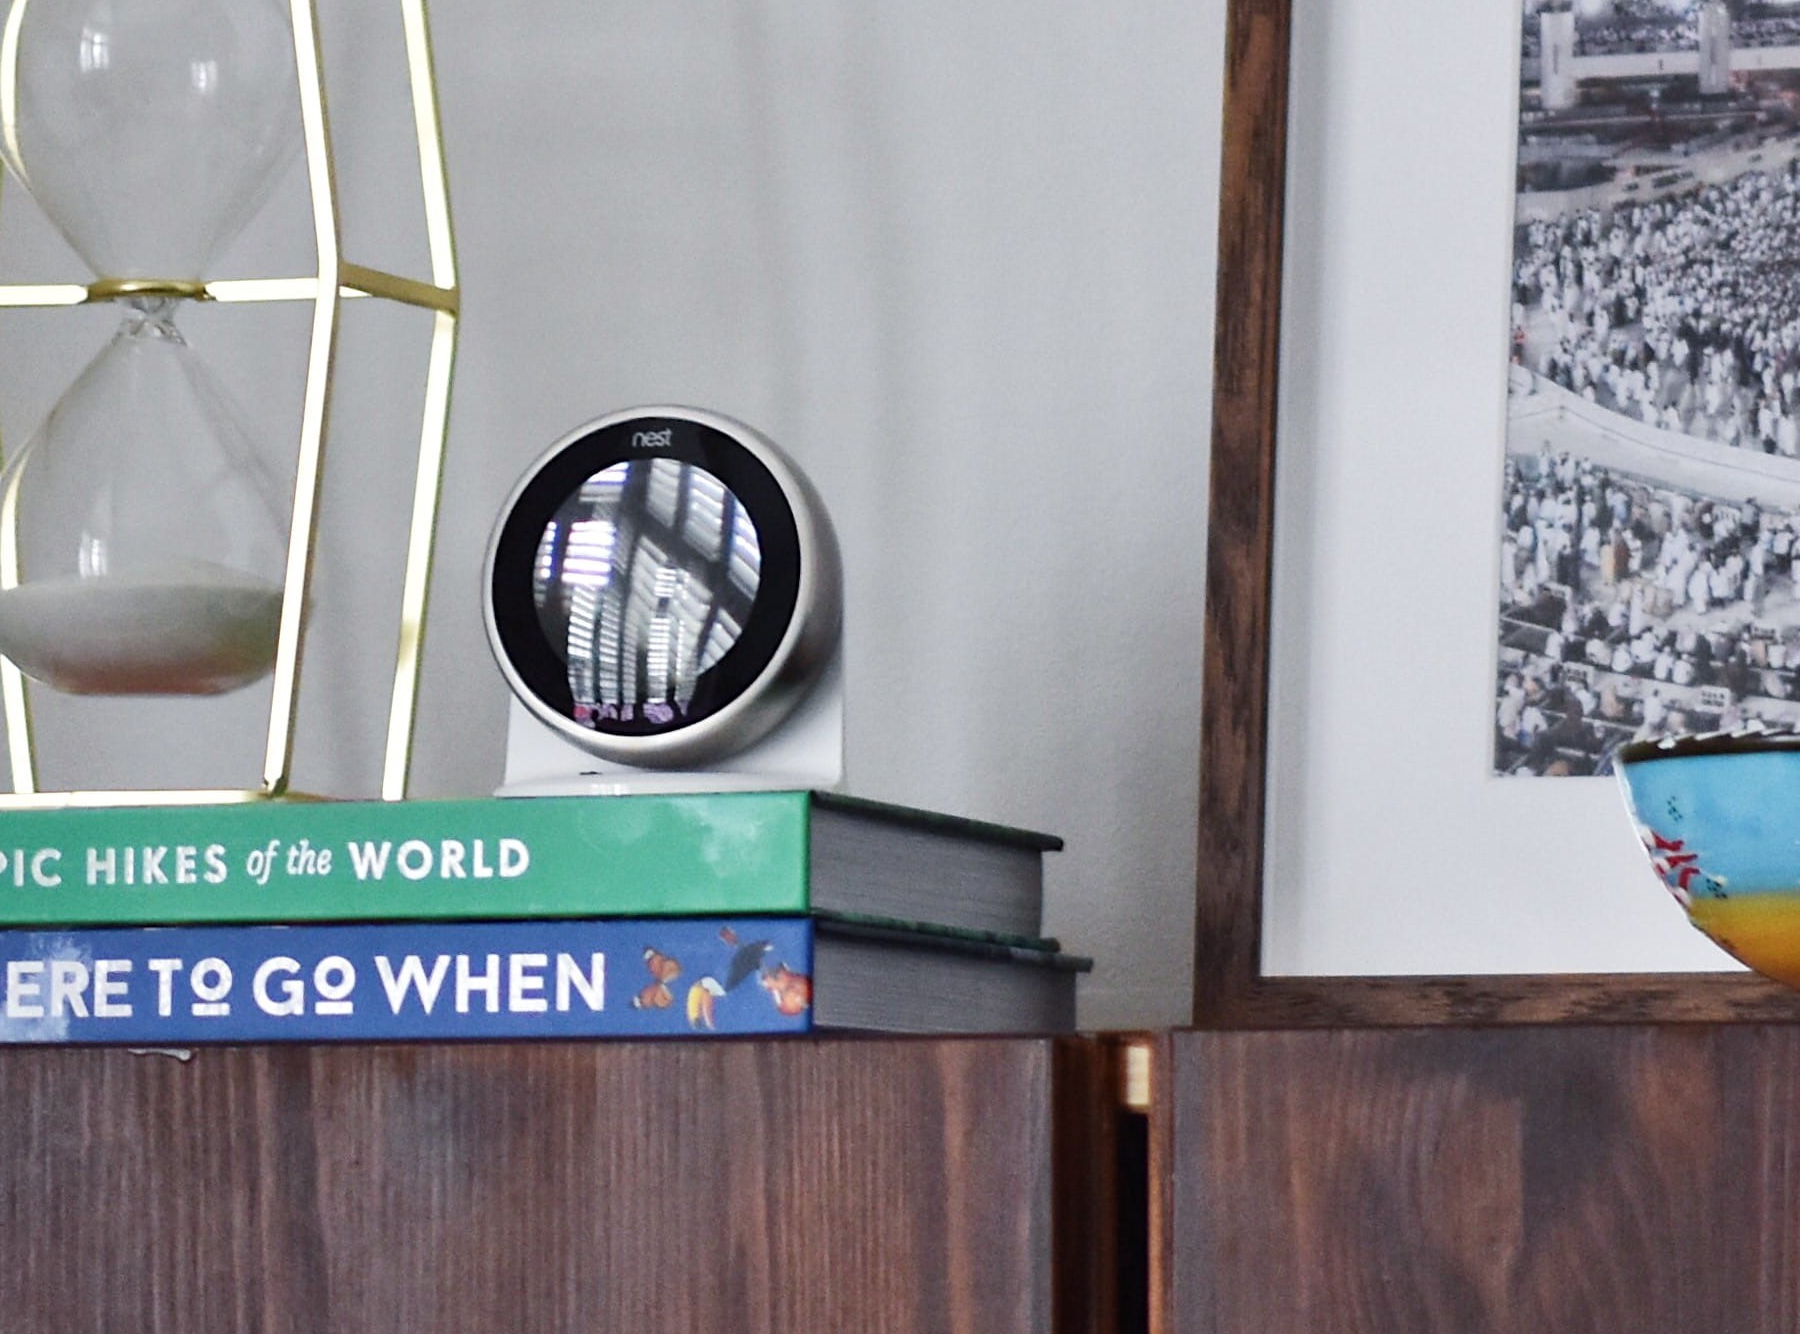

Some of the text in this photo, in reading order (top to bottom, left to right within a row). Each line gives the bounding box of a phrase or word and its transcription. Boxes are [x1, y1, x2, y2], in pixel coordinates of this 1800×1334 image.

[632, 428, 672, 447] nest
[86, 844, 228, 886] HIKES
[246, 840, 281, 886] of
[286, 839, 333, 876] the
[347, 838, 531, 881] WORLD
[252, 955, 357, 1016] GO
[374, 952, 605, 1016] WHEN
